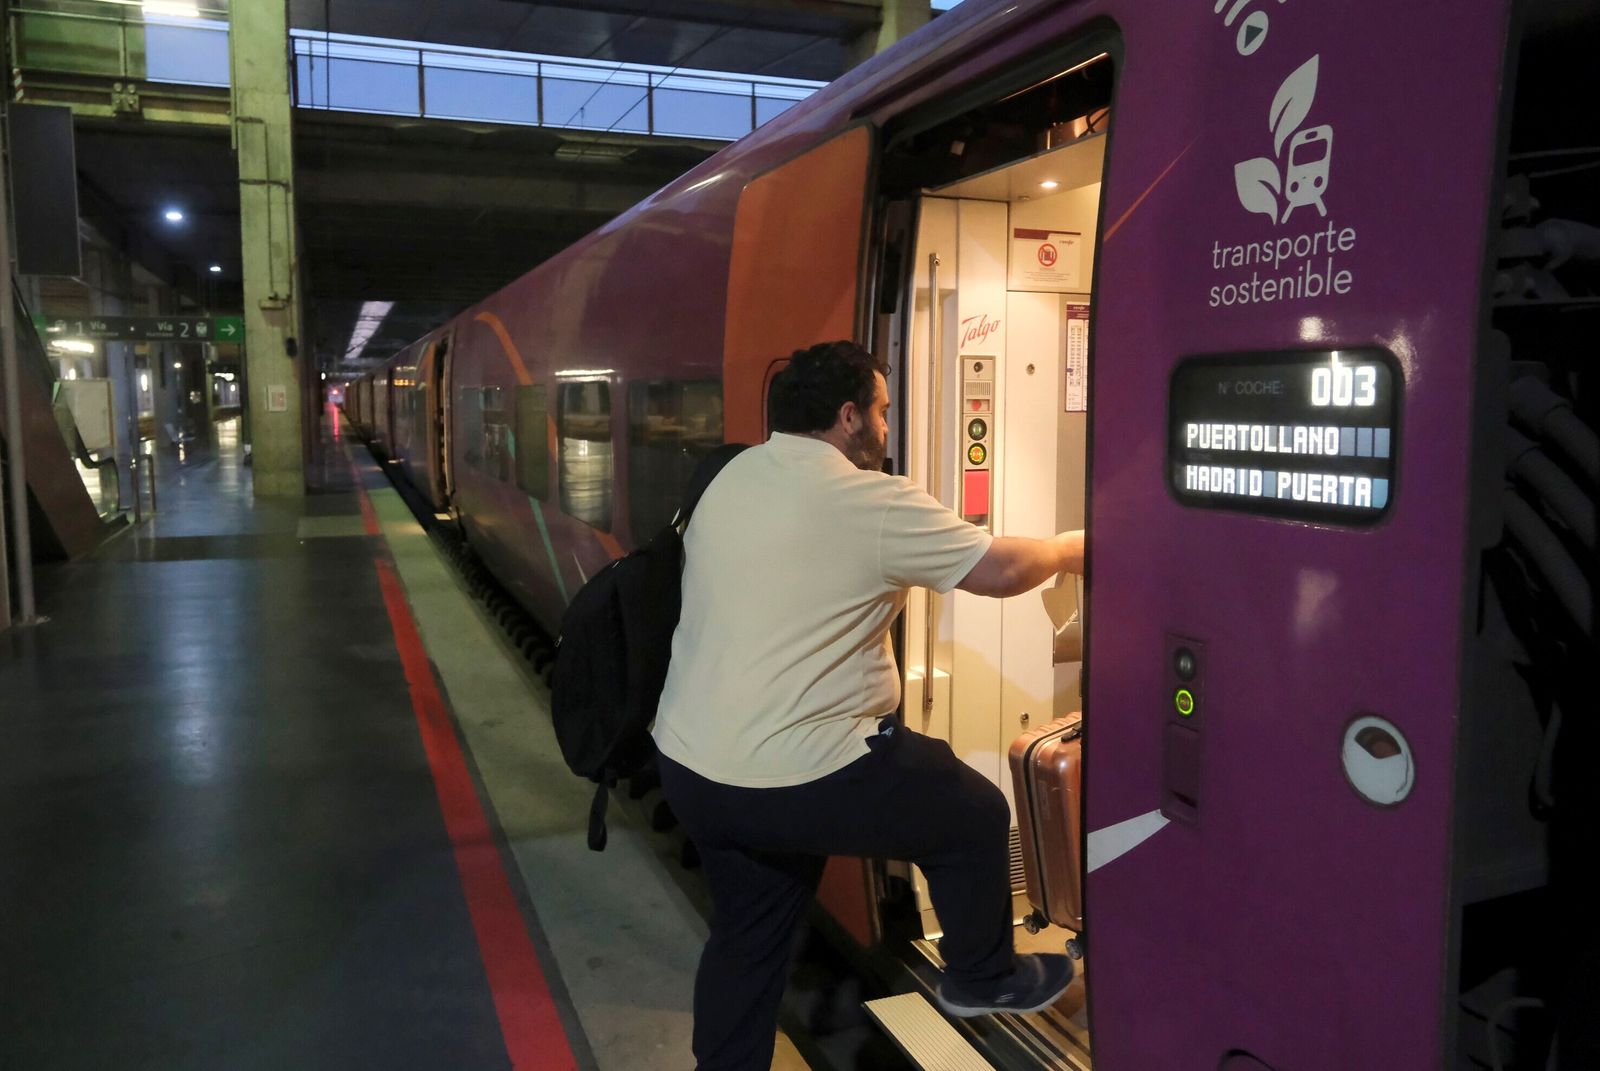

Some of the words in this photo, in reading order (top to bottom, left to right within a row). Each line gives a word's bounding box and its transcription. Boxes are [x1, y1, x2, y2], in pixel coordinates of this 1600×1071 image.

[1212, 221, 1356, 270] transporte
[1209, 257, 1352, 307] sostenible
[179, 322, 189, 337] 2
[961, 314, 1000, 349] Talgo
[1311, 366, 1376, 406] 003
[1186, 423, 1339, 456] PUERTOLLANO
[1186, 464, 1263, 497] MADRID
[1277, 471, 1372, 508] PUERTA
